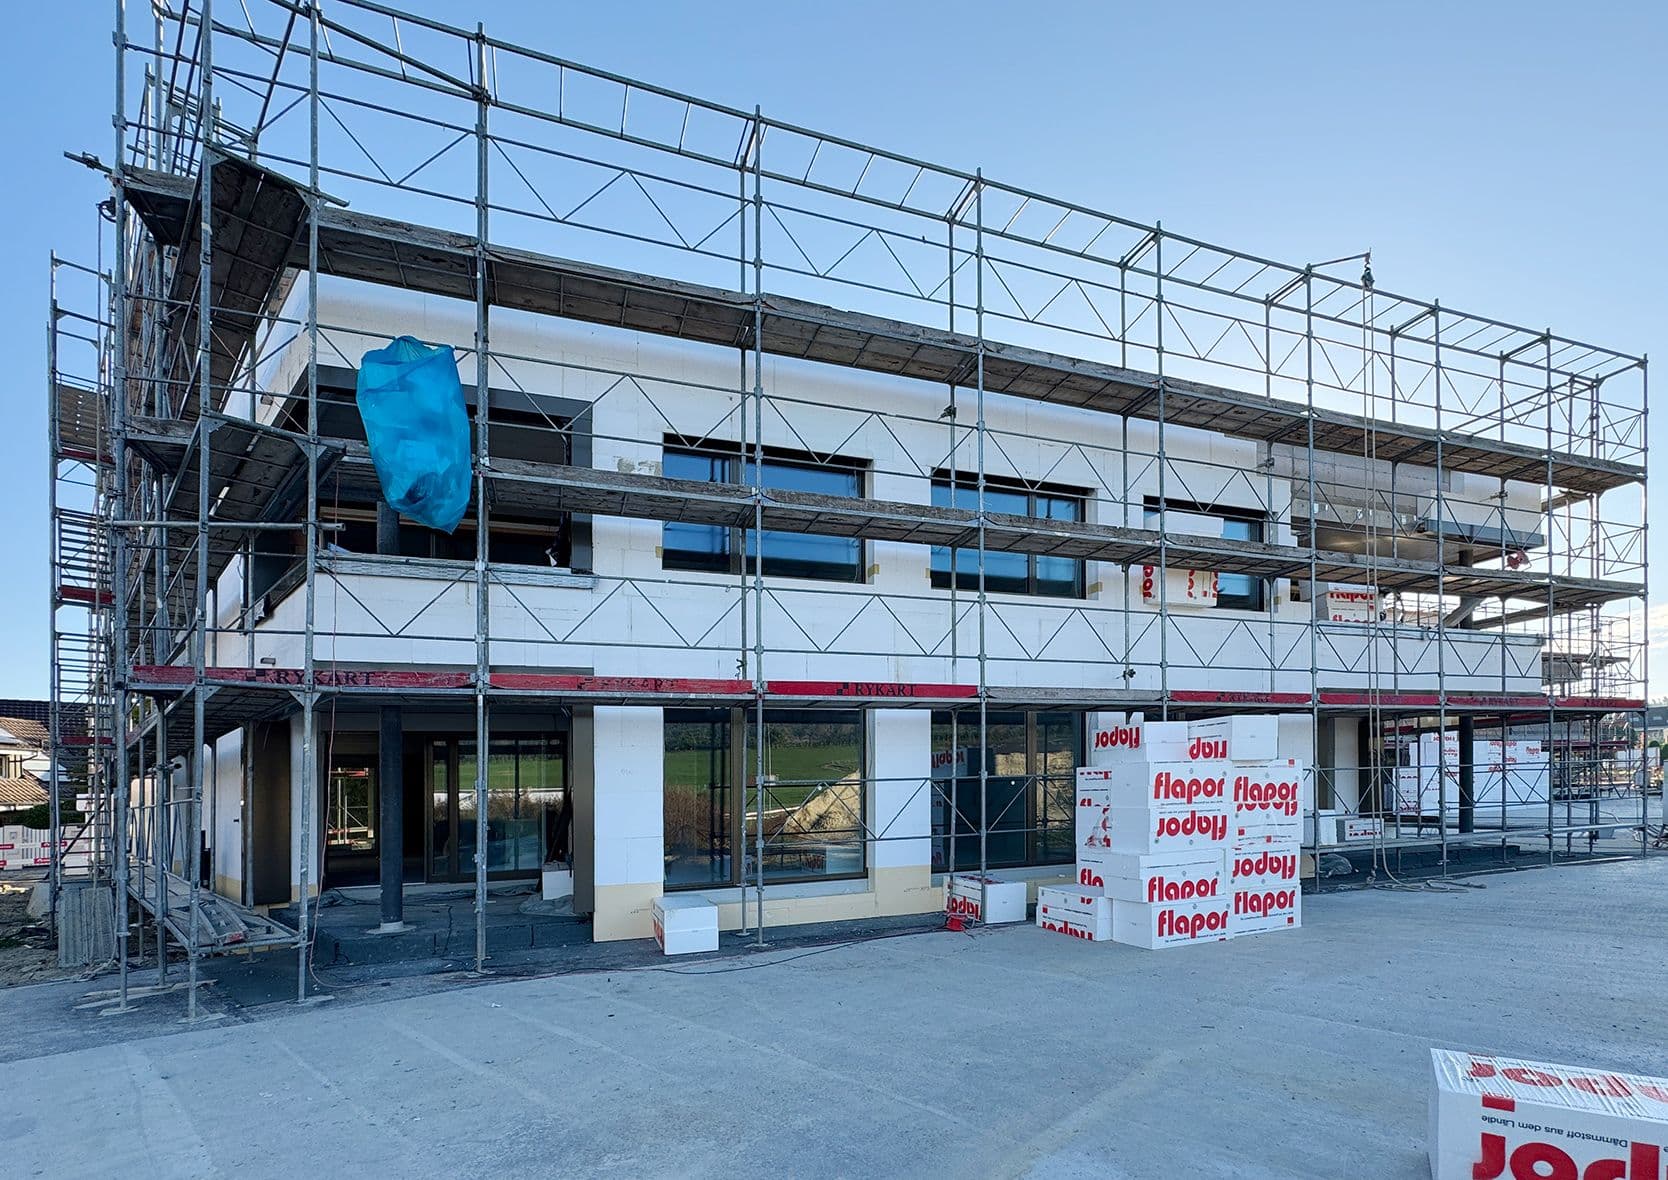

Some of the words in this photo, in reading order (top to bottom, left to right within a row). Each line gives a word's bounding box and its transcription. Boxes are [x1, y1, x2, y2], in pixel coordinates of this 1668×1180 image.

[855, 682, 917, 697] RYKART
[1095, 726, 1140, 748] flapor
[1189, 737, 1227, 760] flap
[1154, 772, 1225, 804] flapor
[1233, 776, 1298, 802] flapor
[1157, 810, 1227, 840] flapor
[1232, 851, 1296, 879] flapor
[1148, 876, 1218, 903] flapor
[1234, 890, 1296, 918] flapor
[1158, 910, 1228, 939] flapor
[1482, 1115, 1515, 1128] Ländle
[1519, 1122, 1543, 1133] dem
[1545, 1126, 1564, 1136] aus
[1566, 1130, 1628, 1148] Dämmstoff
